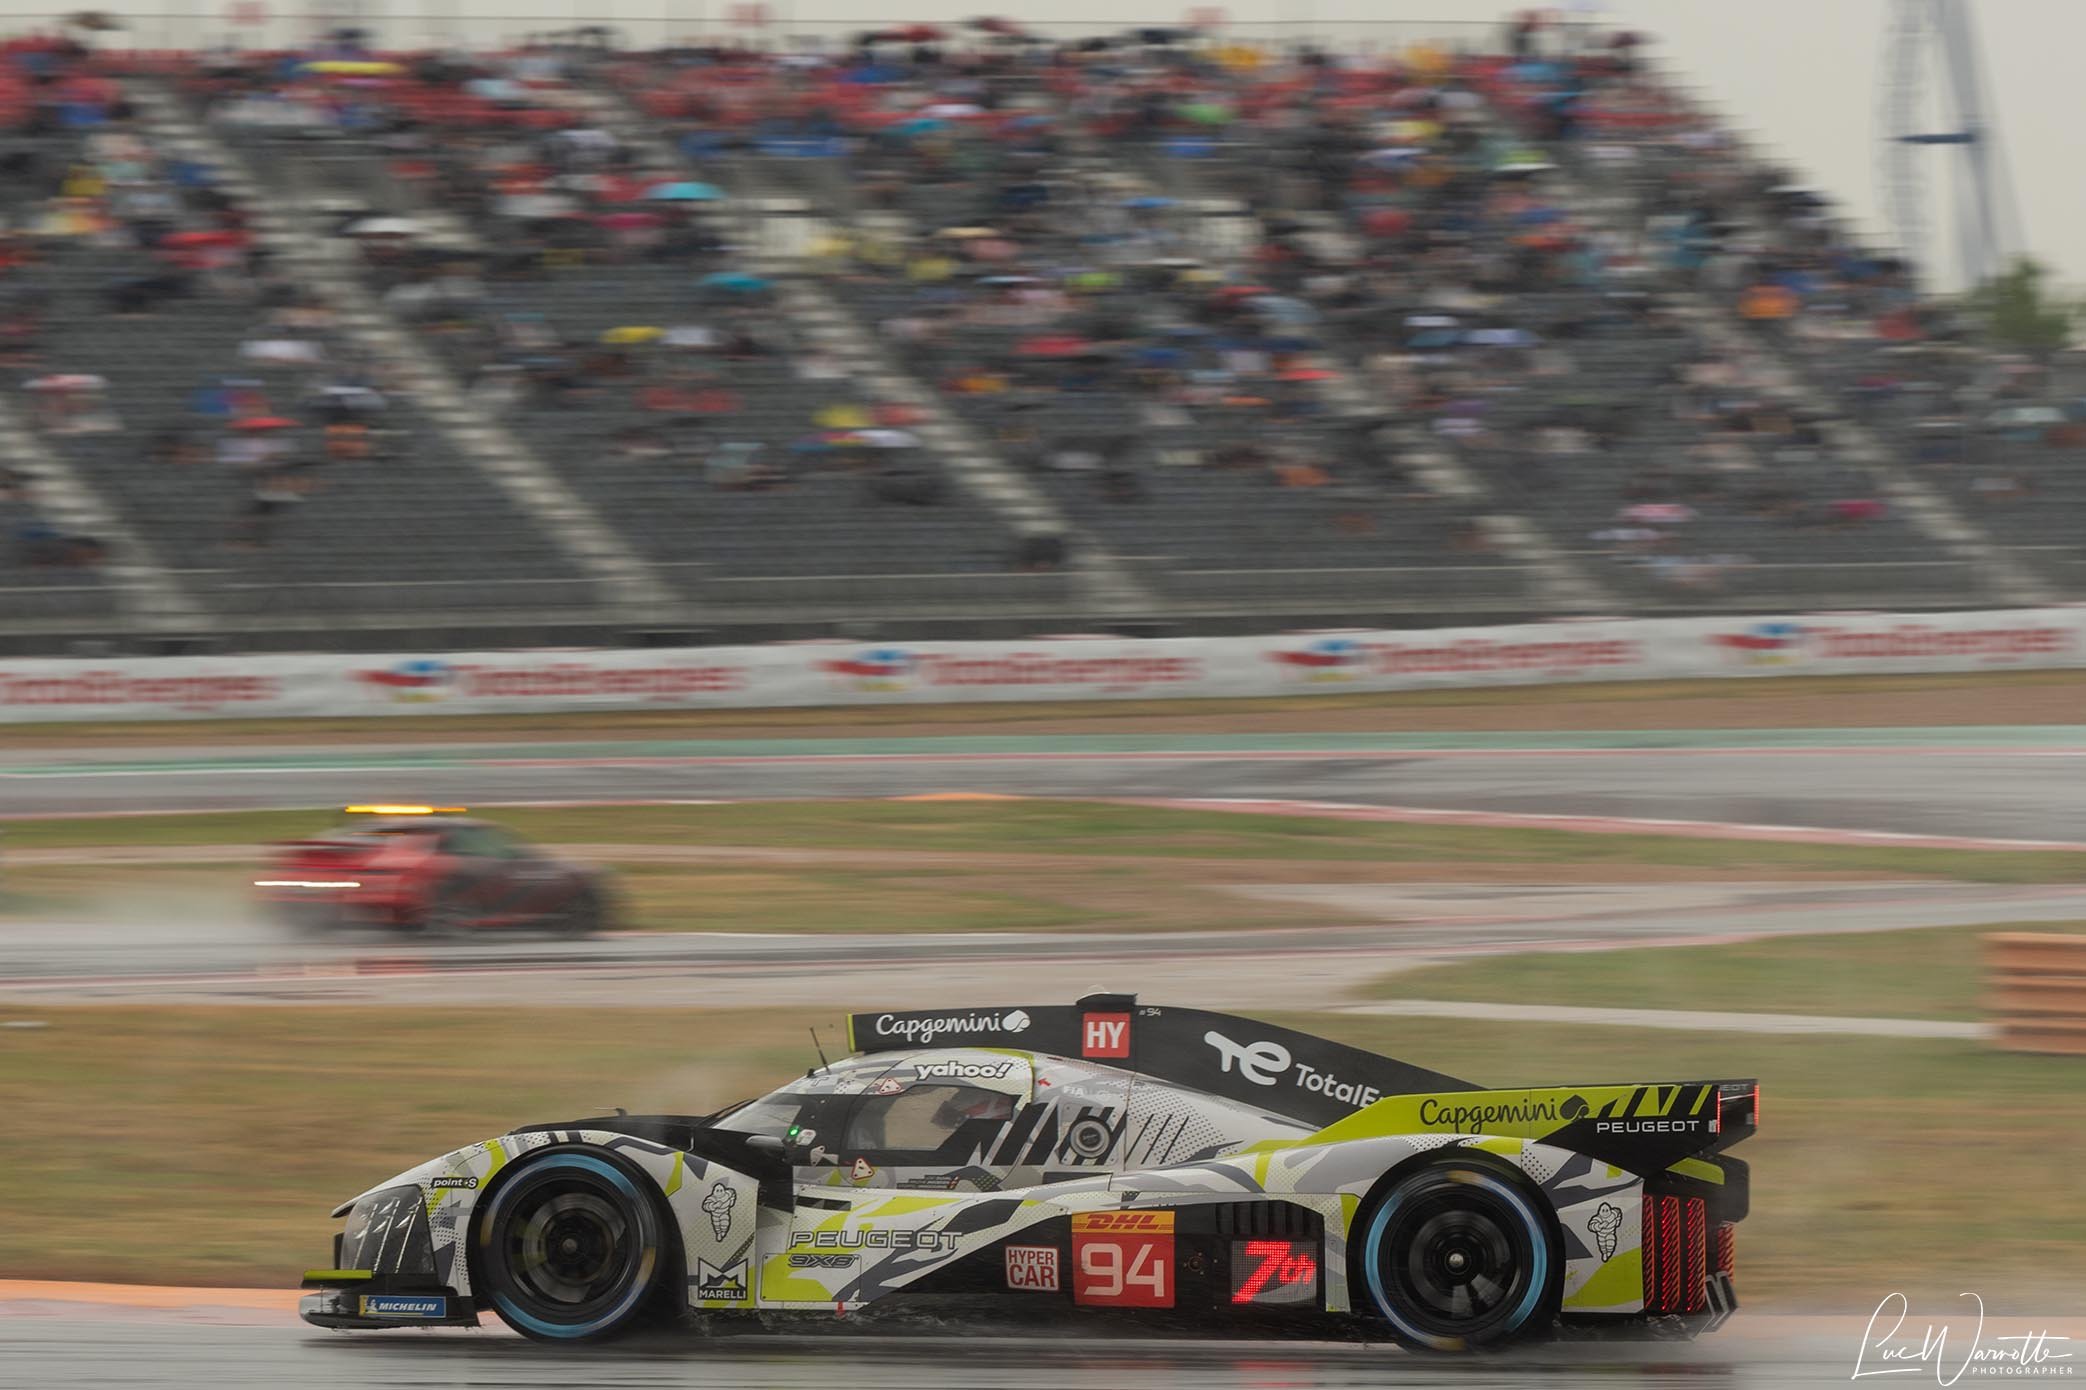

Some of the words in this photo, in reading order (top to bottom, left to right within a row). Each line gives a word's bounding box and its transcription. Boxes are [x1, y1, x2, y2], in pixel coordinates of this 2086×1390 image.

[876, 1012, 1002, 1043] Capgemini
[1087, 1022, 1126, 1048] HY
[914, 1060, 1013, 1080] yahoo!
[1295, 1063, 1384, 1107] TotalE
[1420, 1098, 1558, 1134] Capgemini
[1597, 1120, 1700, 1133] PEUGEOT
[1087, 1214, 1160, 1230] DHL
[789, 1230, 964, 1249] PEUGEOT
[1008, 1249, 1055, 1265] HYPER
[1009, 1264, 1055, 1288] CAR
[1081, 1243, 1165, 1297] 94
[699, 1290, 746, 1299] MARELLI
[378, 1301, 437, 1312] MICHELIN
